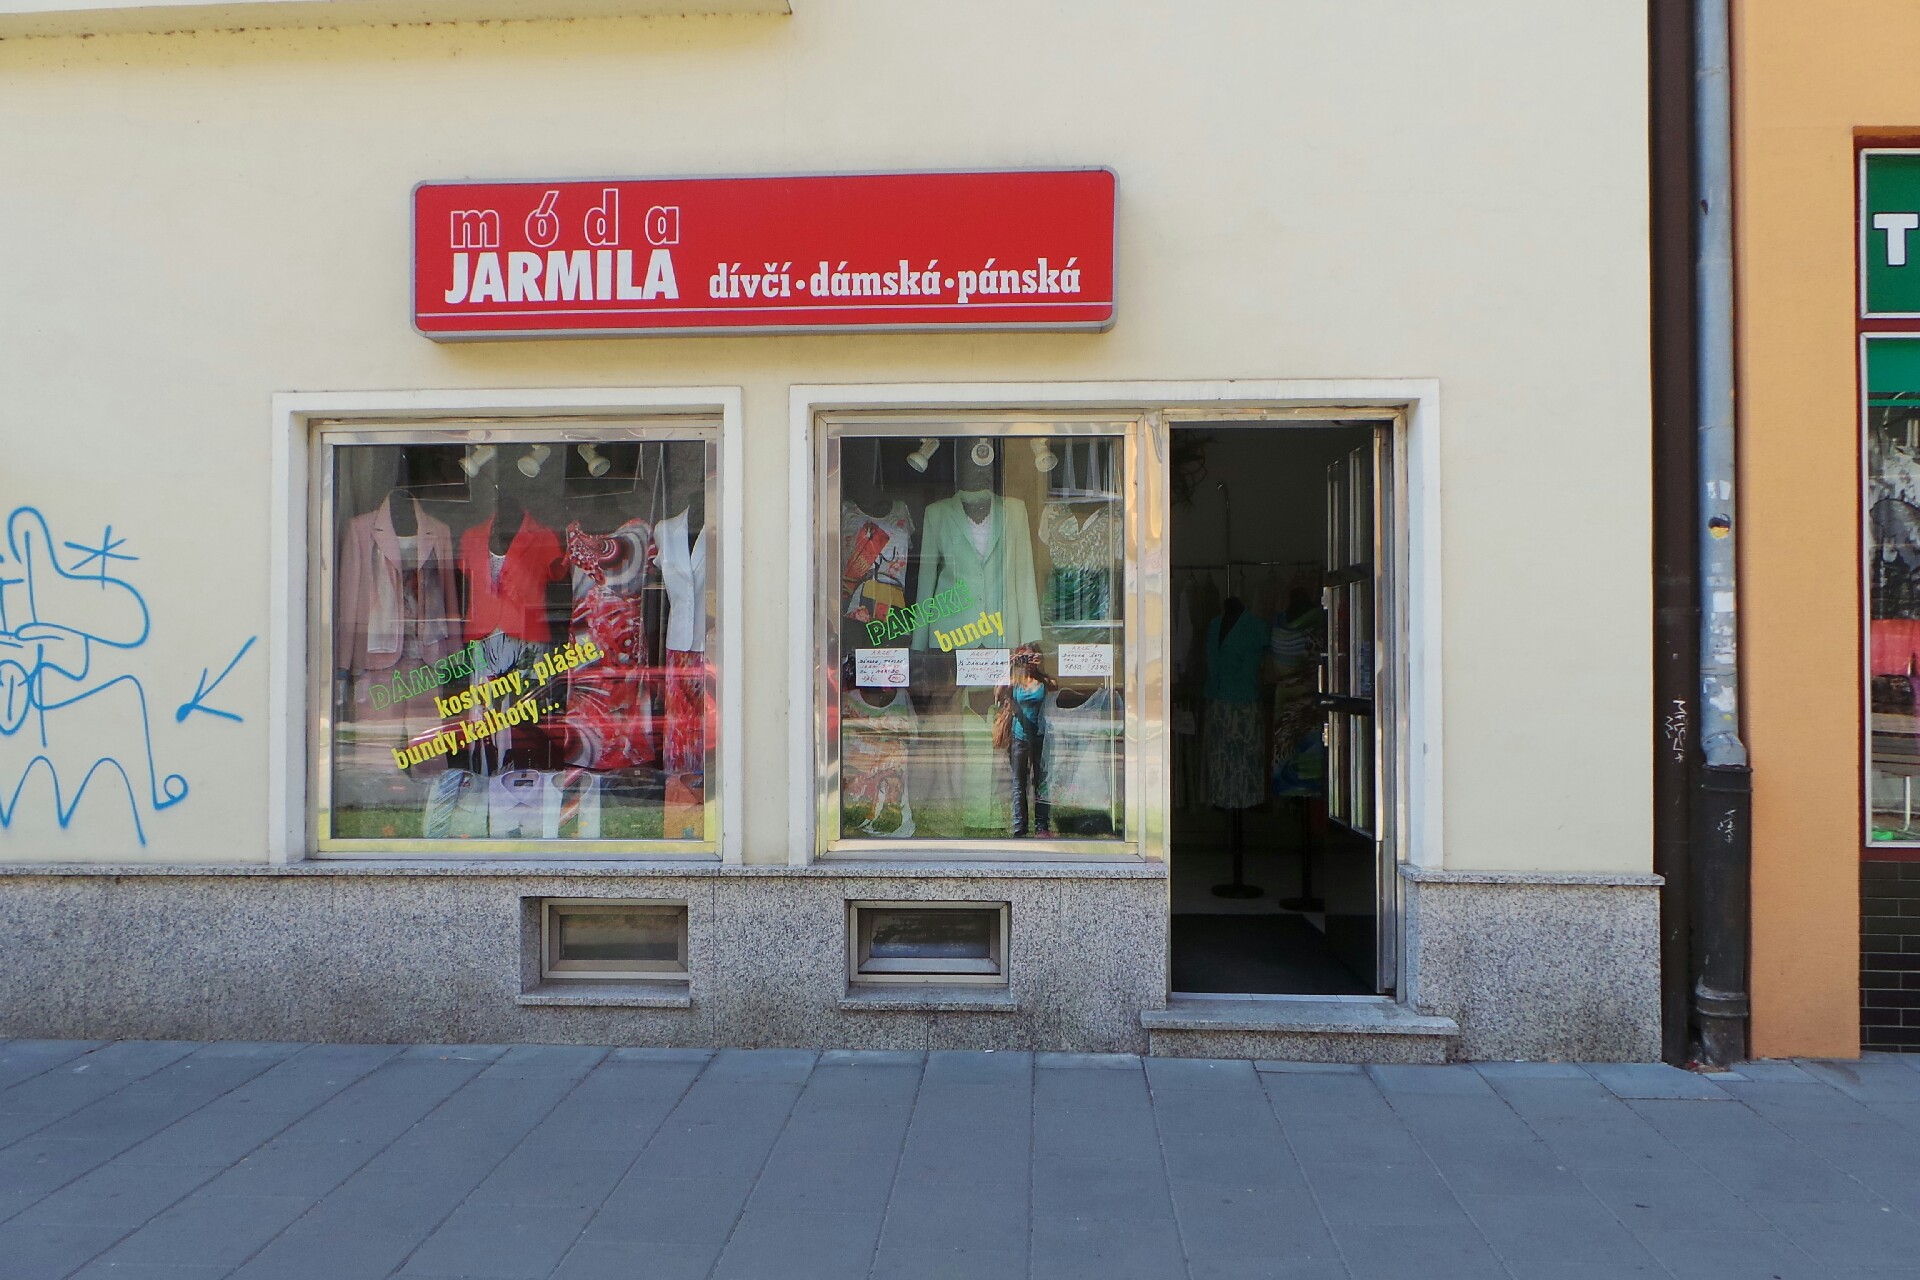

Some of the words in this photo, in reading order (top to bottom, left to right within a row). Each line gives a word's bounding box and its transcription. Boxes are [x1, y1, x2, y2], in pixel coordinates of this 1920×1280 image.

[450, 188, 679, 249] móda
[444, 249, 680, 304] JARMILA
[809, 259, 941, 297] dámská
[957, 256, 1081, 304] pánská
[933, 610, 1005, 653] bundy
[368, 639, 490, 711] DÁMSKÉ
[433, 669, 530, 719] kostýmy,
[533, 636, 605, 686] pláště,
